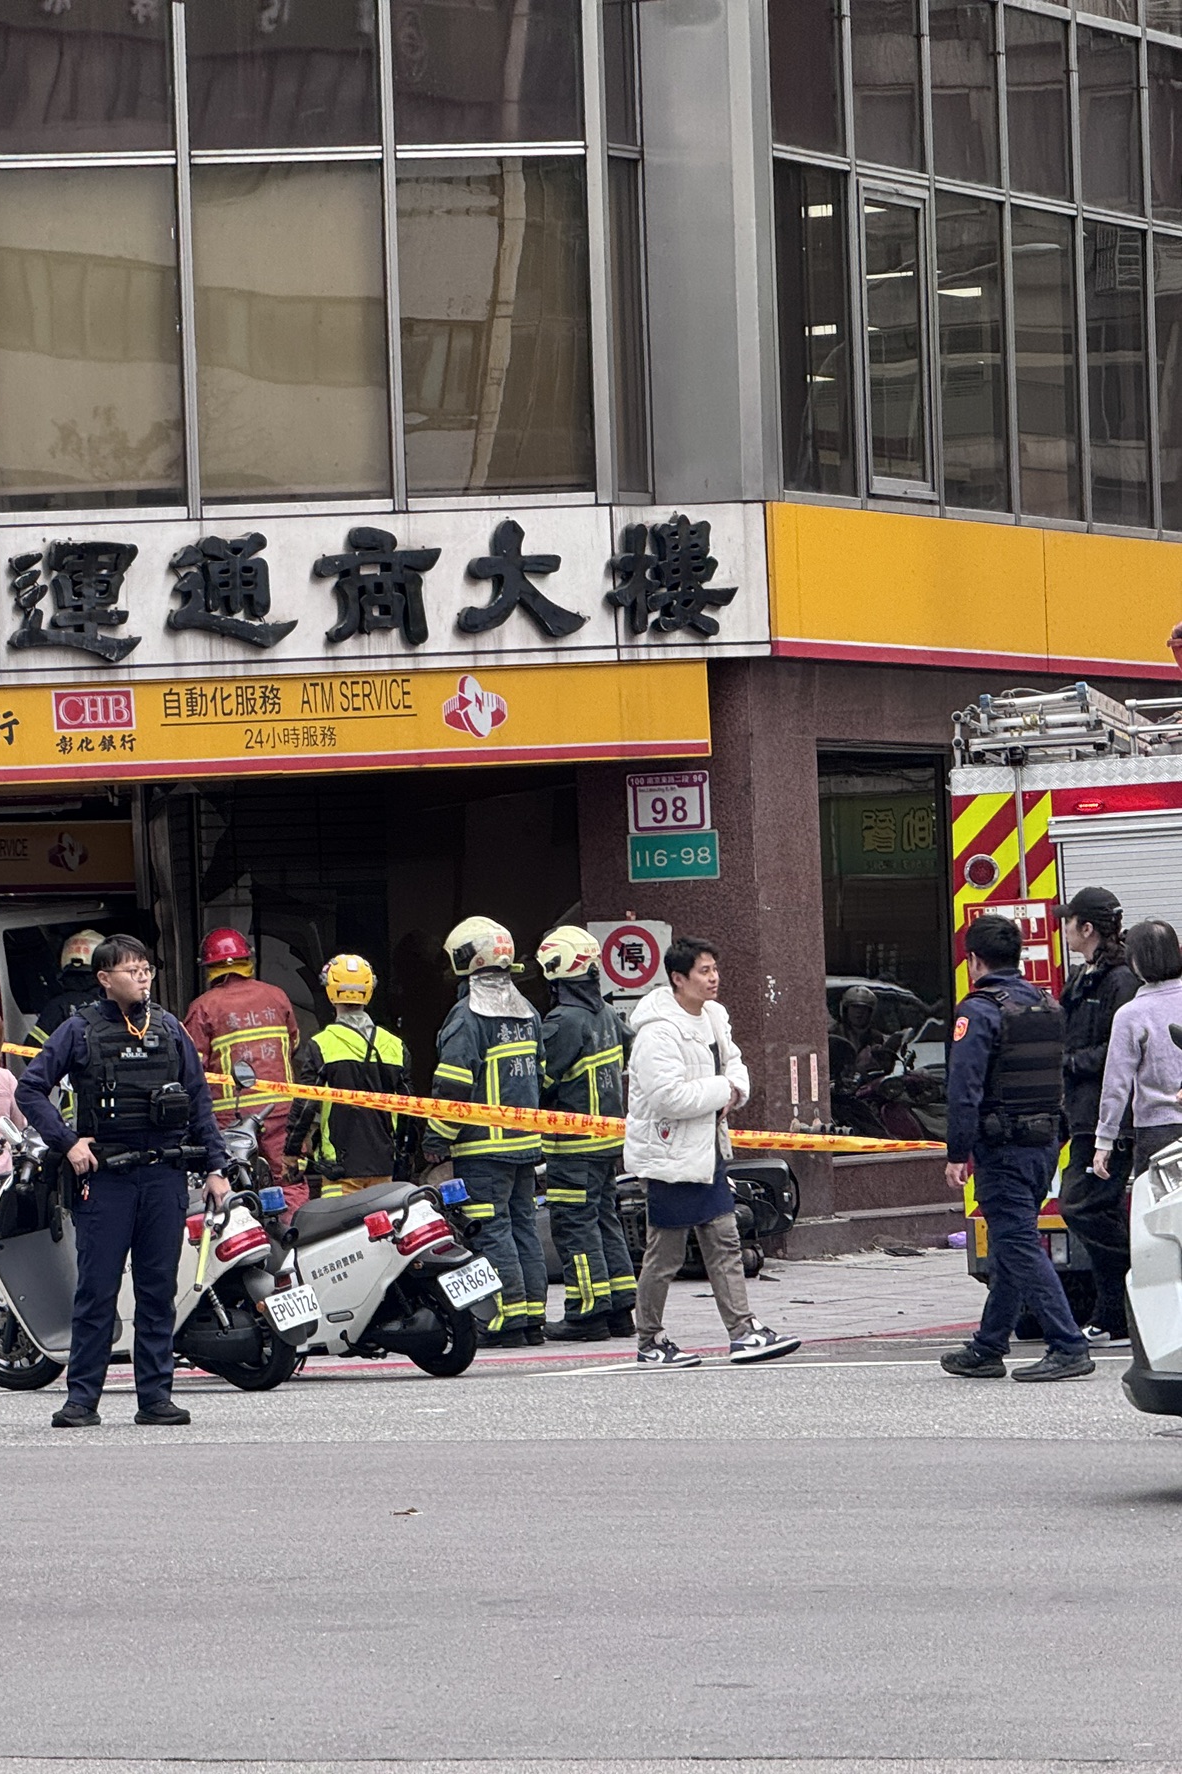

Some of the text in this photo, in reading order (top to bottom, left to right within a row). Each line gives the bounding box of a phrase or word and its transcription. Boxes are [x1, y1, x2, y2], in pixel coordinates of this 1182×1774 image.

[58, 695, 130, 725] CHB
[162, 679, 412, 718] 自動化服務 ATM SERVICE
[56, 733, 136, 755] 彰化銀行
[244, 725, 337, 749] 24小時服務
[651, 796, 688, 824] 98
[636, 847, 712, 867] 116-98
[617, 942, 645, 971] 停
[271, 1293, 318, 1322] EPU-1726
